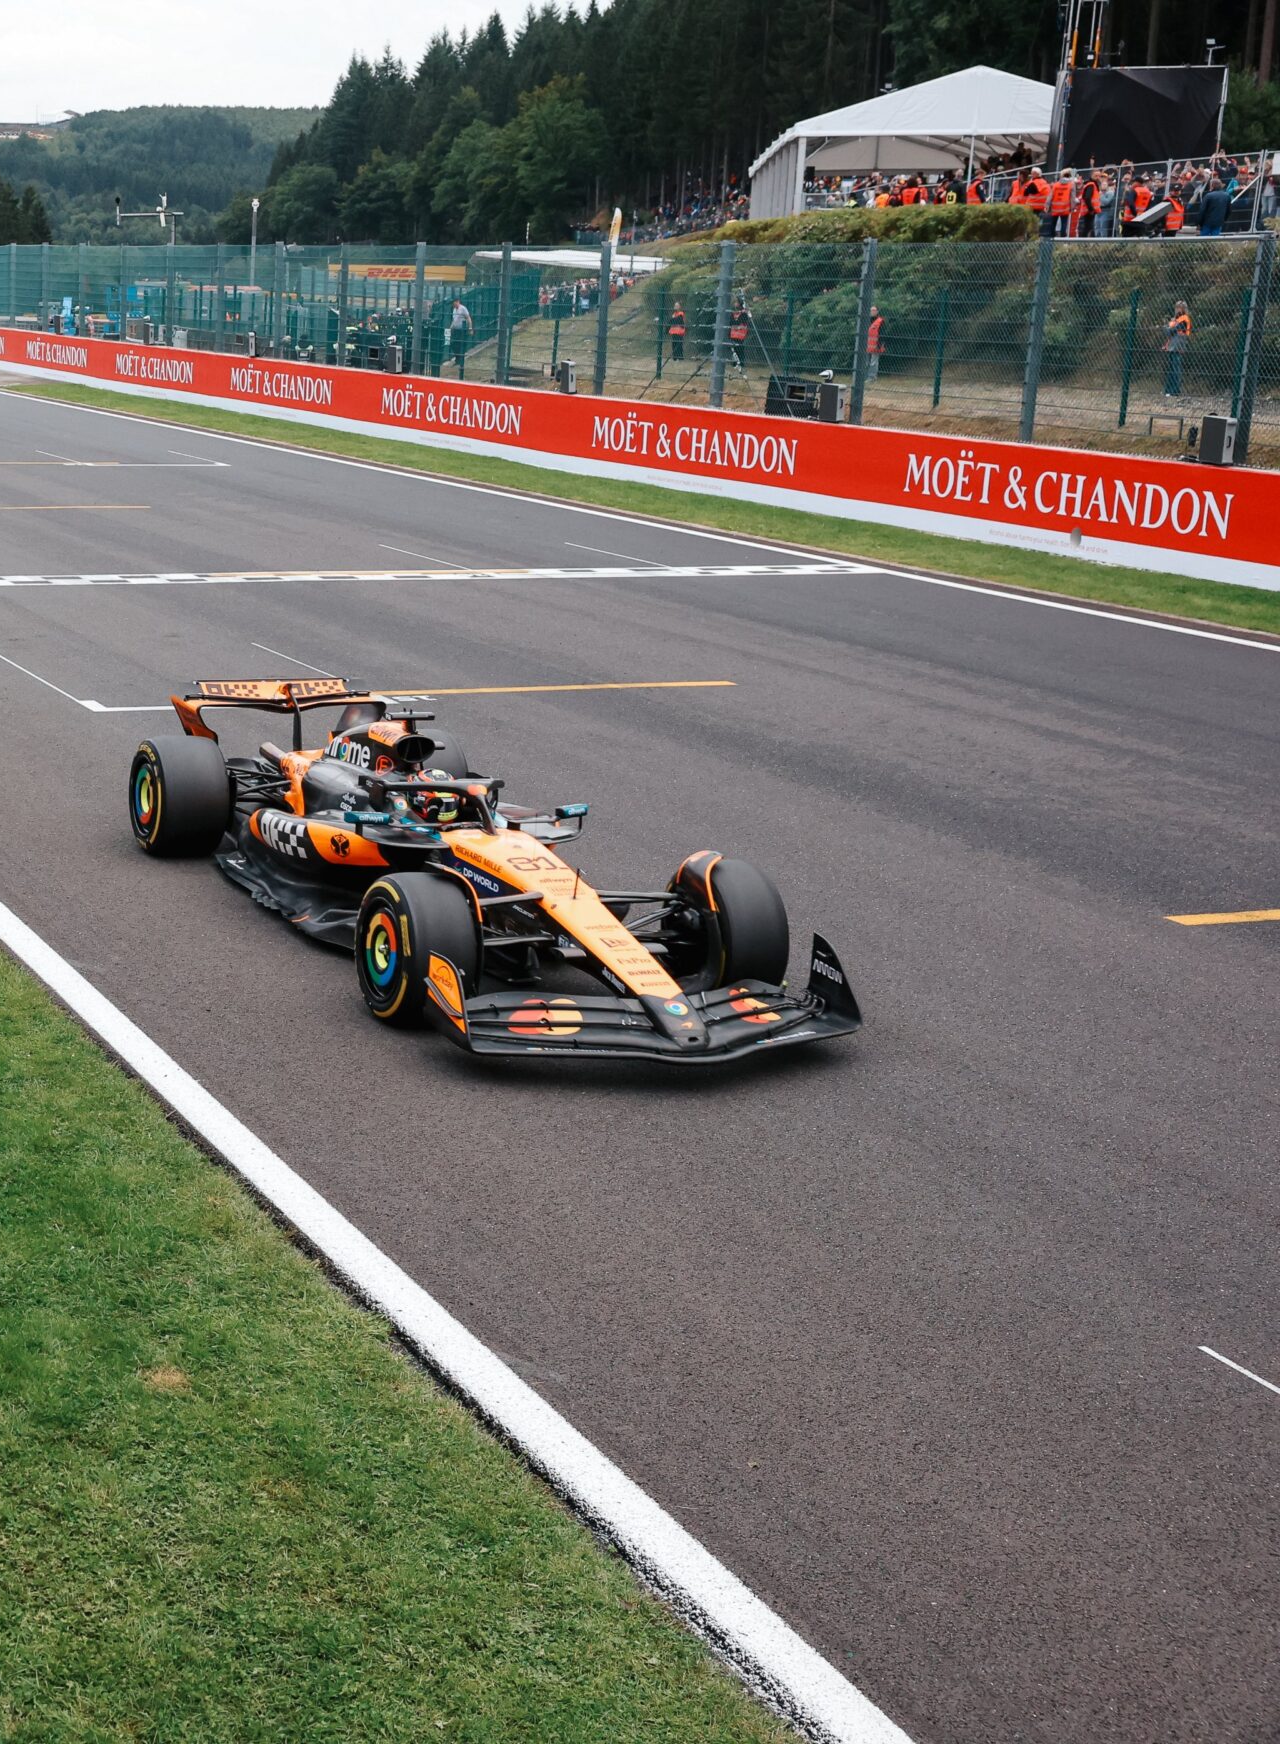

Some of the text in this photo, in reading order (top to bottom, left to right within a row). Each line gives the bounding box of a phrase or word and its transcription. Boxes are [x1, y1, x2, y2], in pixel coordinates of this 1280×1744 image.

[26, 337, 88, 368] MOËT & CHANDON
[115, 350, 194, 384] MOËT & CHANDON
[230, 364, 333, 405] MOËT & CHANDON
[381, 384, 523, 435] MOËT & CHANDON
[591, 412, 798, 476] MOËT & CHANDON
[903, 450, 1235, 540] MOËT & CHANDON
[358, 813, 384, 823] allwyn
[455, 844, 503, 873] RICHARD MILLE
[463, 867, 499, 893] DP WORLD
